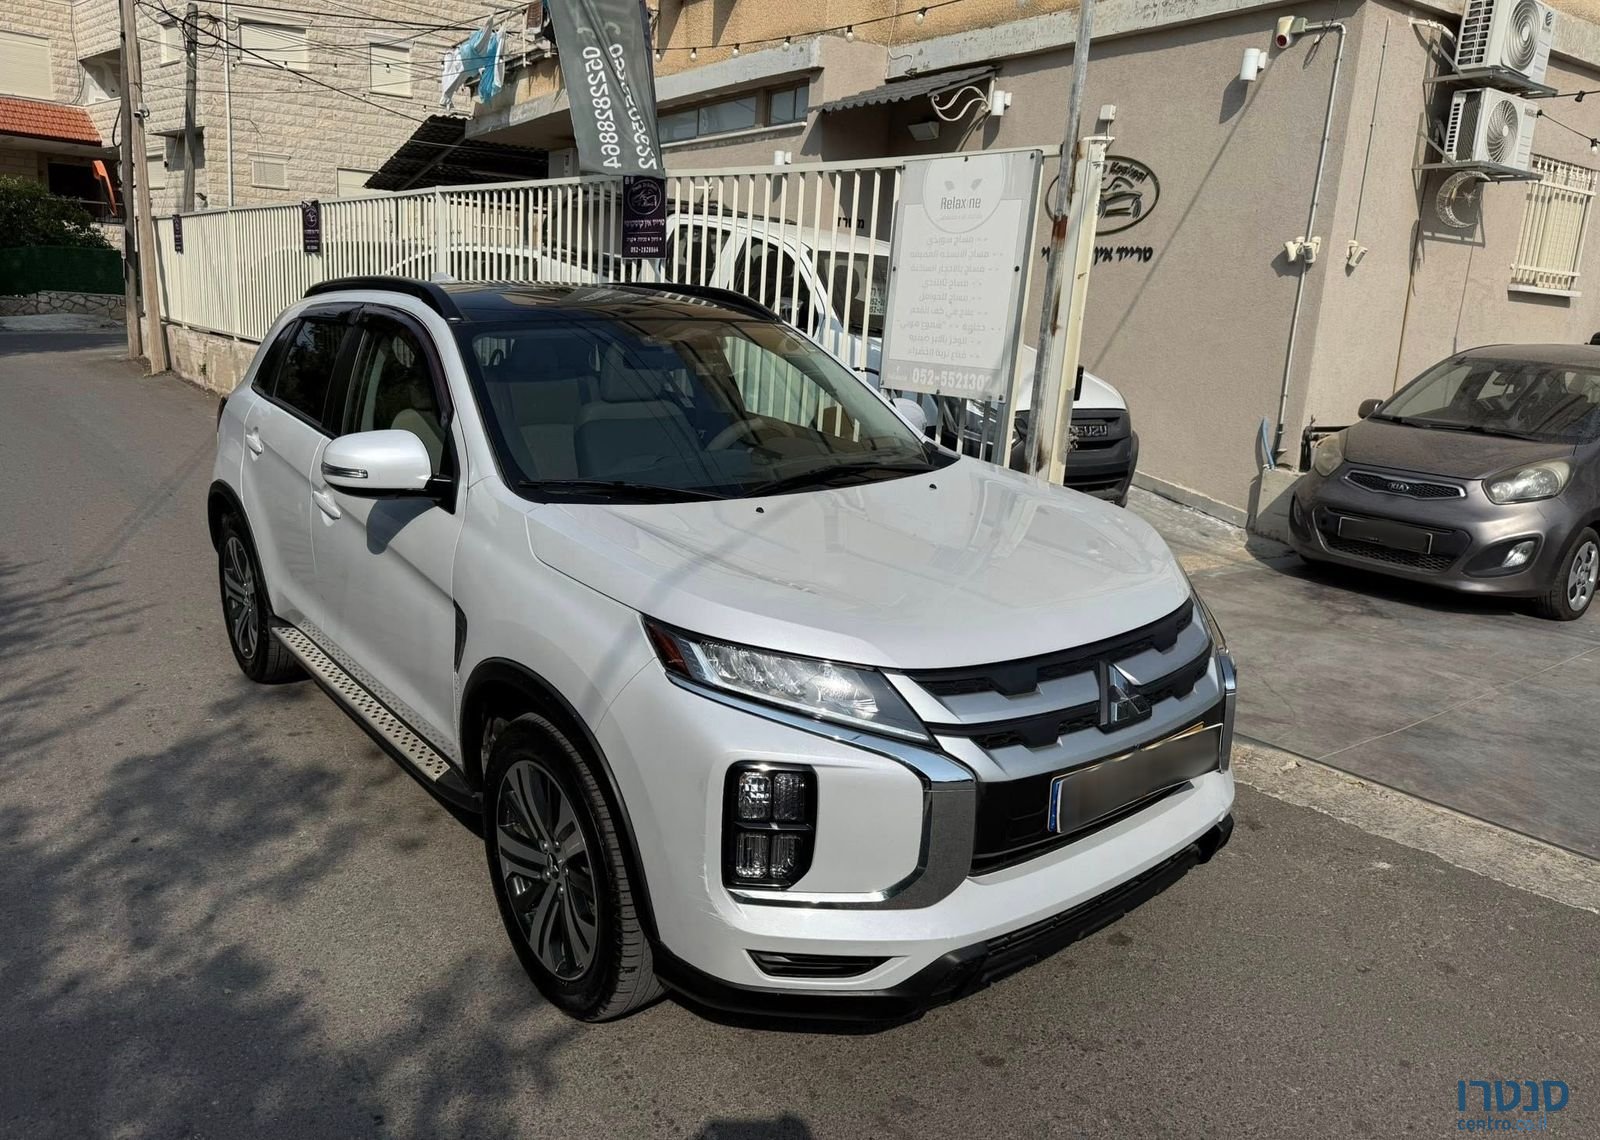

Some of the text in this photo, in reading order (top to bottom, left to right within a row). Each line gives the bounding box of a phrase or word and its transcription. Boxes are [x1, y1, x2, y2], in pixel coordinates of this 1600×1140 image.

[1093, 245, 1154, 266] טרייד אין
[1071, 424, 1107, 437] SUZU
